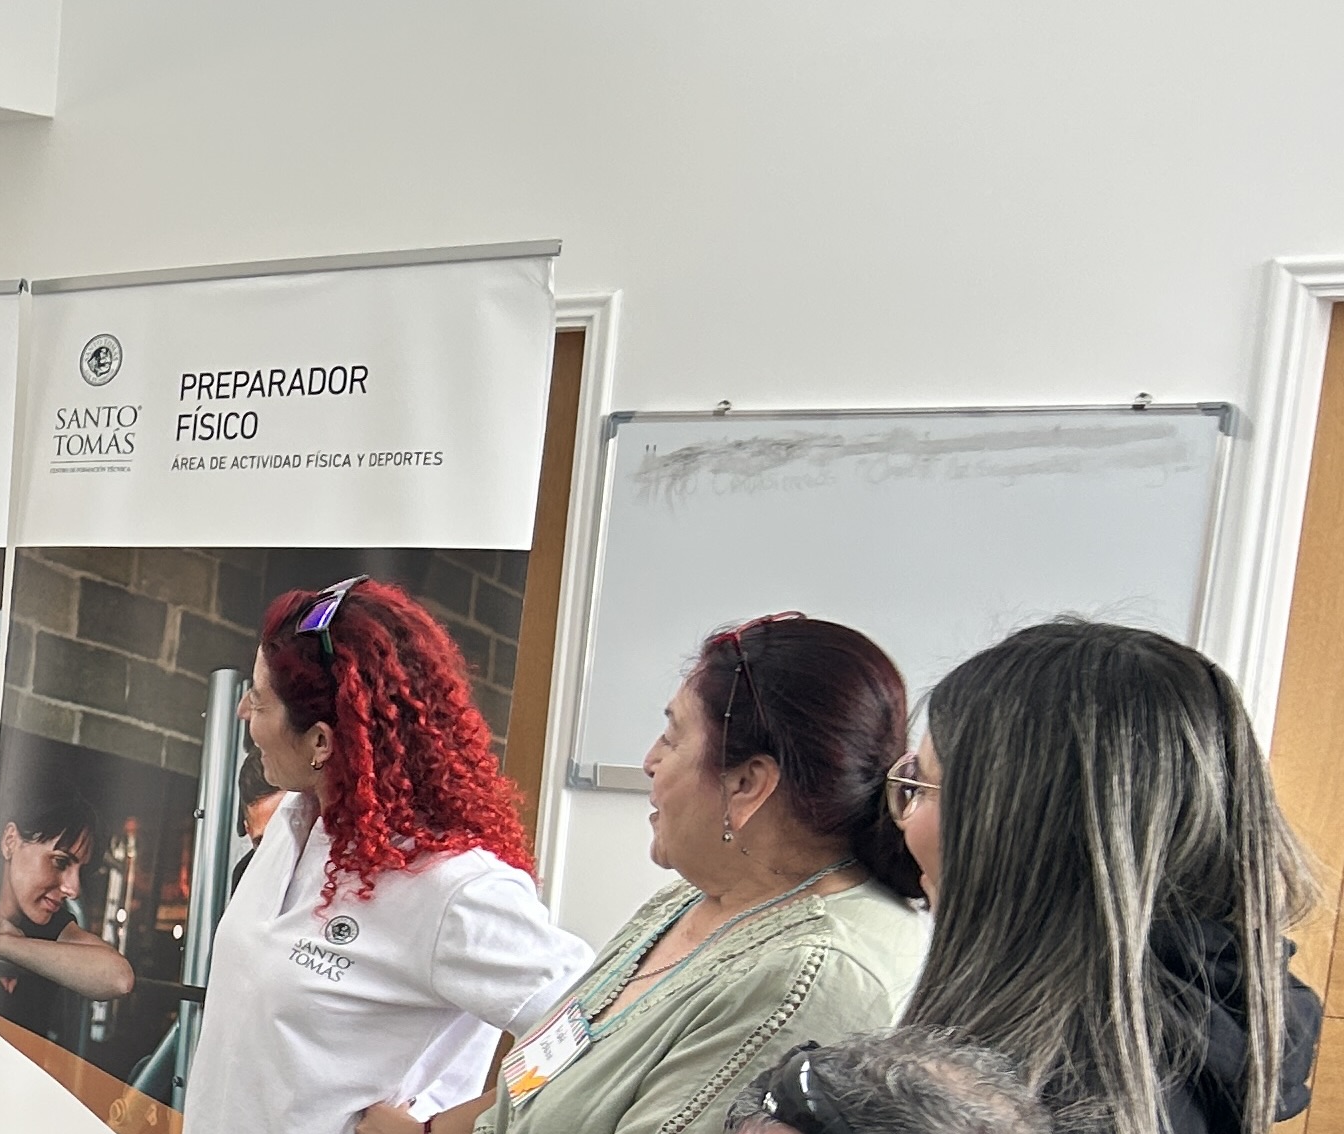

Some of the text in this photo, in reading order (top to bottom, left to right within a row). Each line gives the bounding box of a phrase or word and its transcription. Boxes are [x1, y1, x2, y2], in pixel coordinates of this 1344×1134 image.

[180, 365, 369, 401] PREPARADOR
[55, 405, 138, 430] SANTO
[175, 405, 259, 441] FÍSICO
[53, 428, 136, 456] TOMÁS
[171, 450, 444, 471] ÁREA DE ACTIVIDAD FÍSICA Y DEPORTES
[294, 938, 351, 970] SANTO
